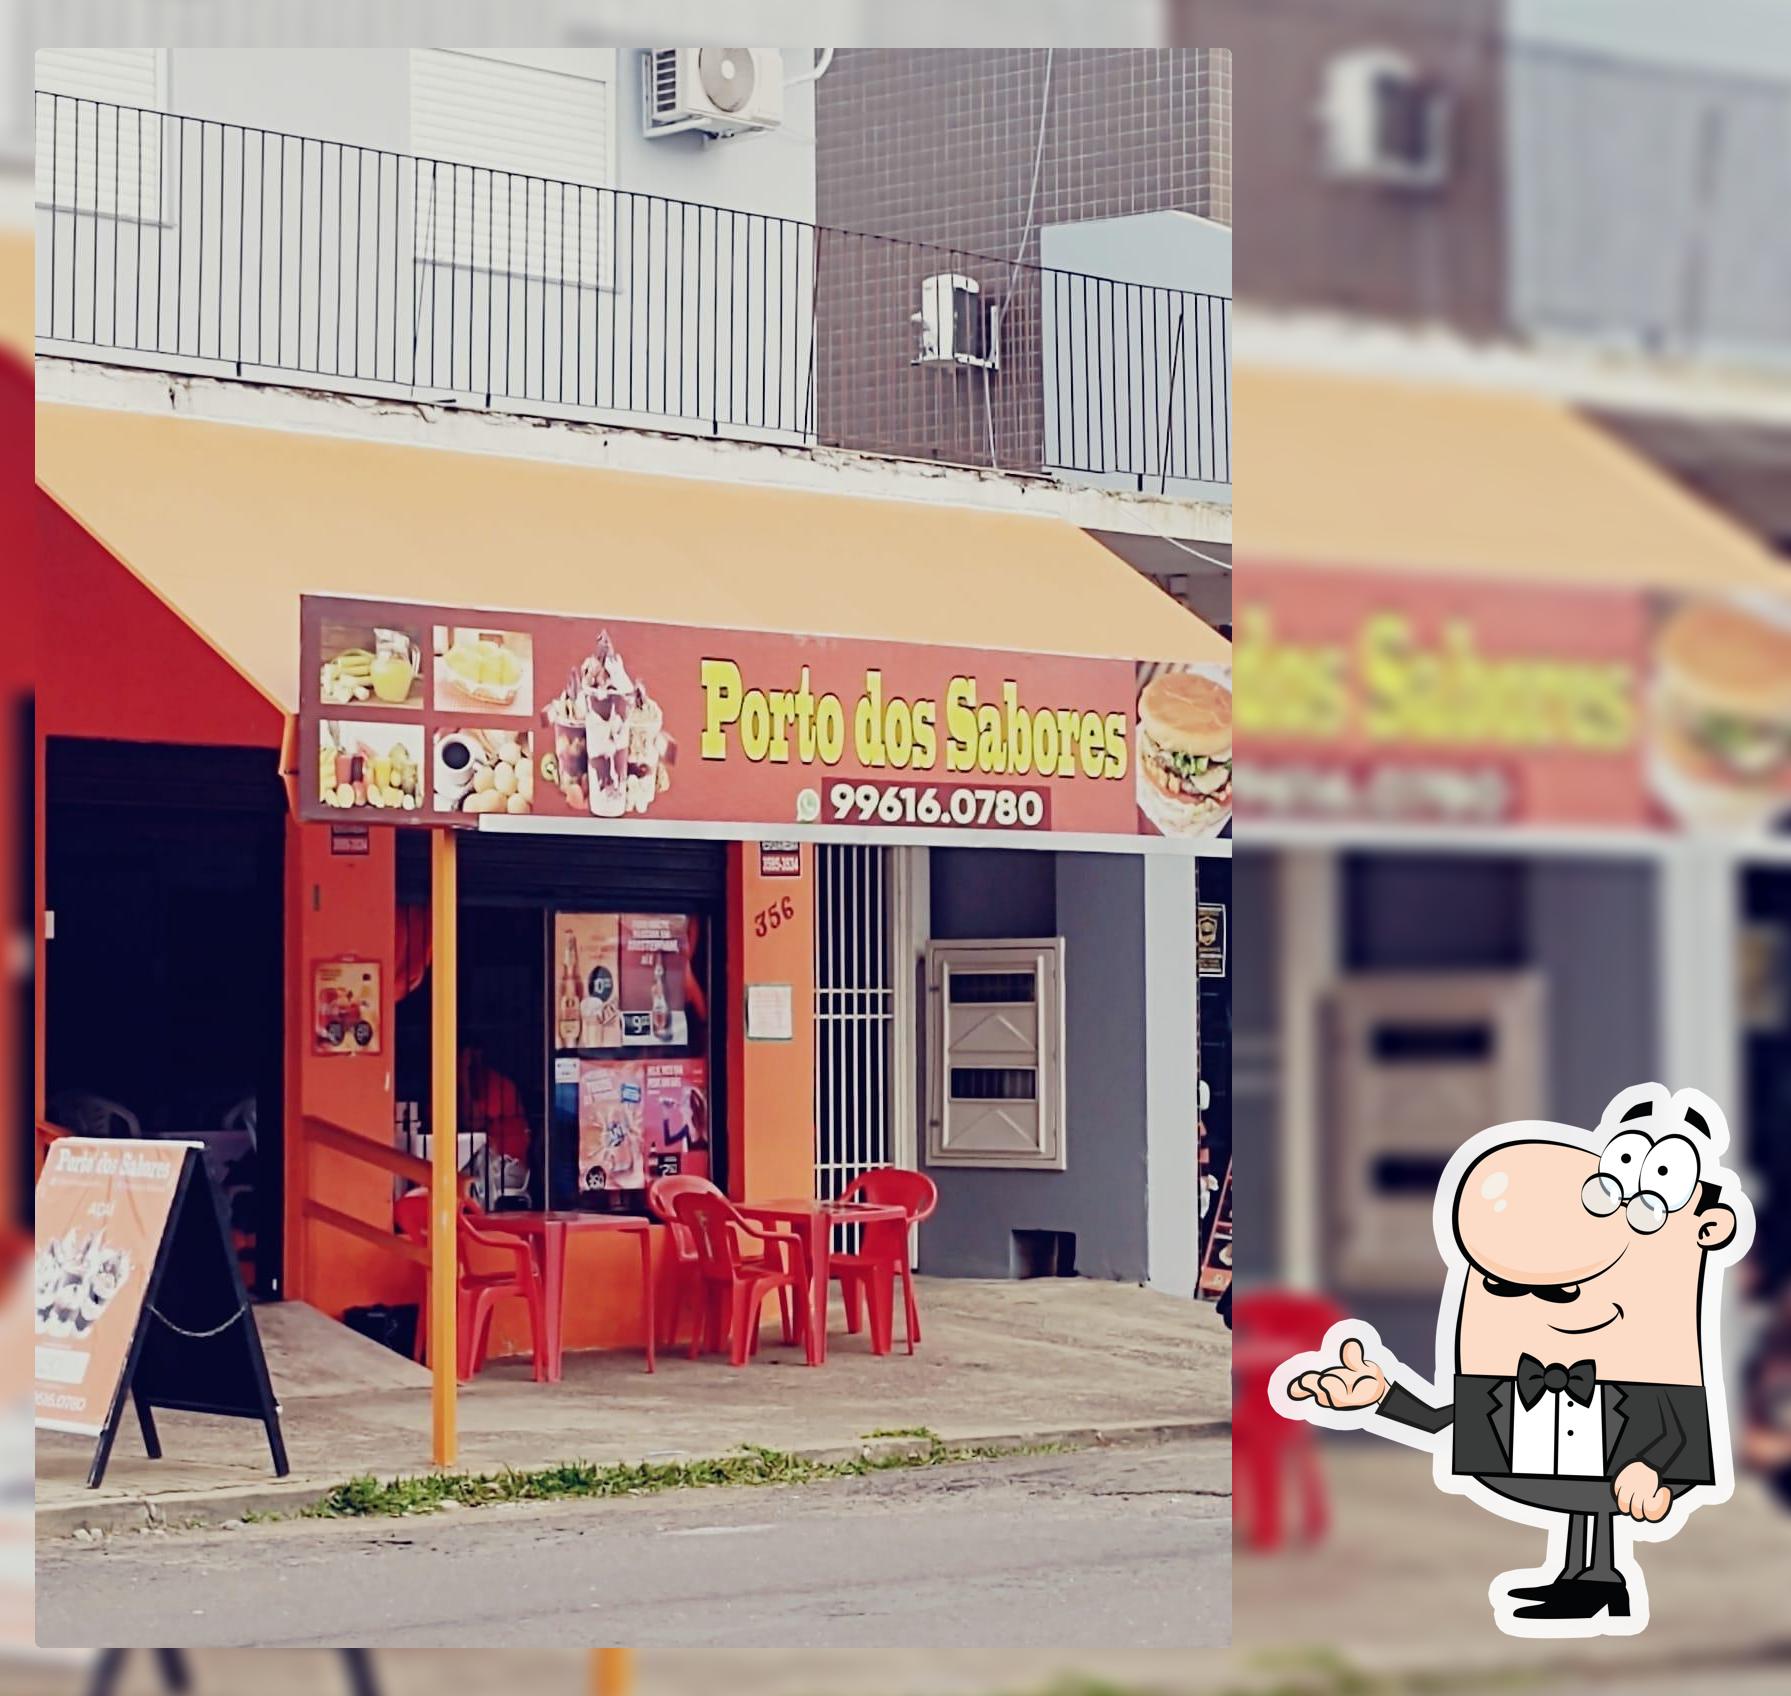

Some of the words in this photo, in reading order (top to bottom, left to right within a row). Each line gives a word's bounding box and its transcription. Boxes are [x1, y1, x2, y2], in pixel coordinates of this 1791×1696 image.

[700, 656, 846, 766] Porto
[854, 667, 938, 771] dos
[946, 674, 1129, 781] Sabores
[829, 782, 1045, 827] 99616.0780
[754, 895, 795, 938] 356
[55, 1147, 94, 1174] Porto
[95, 1150, 118, 1176] dos
[119, 1150, 171, 1179] Sabores
